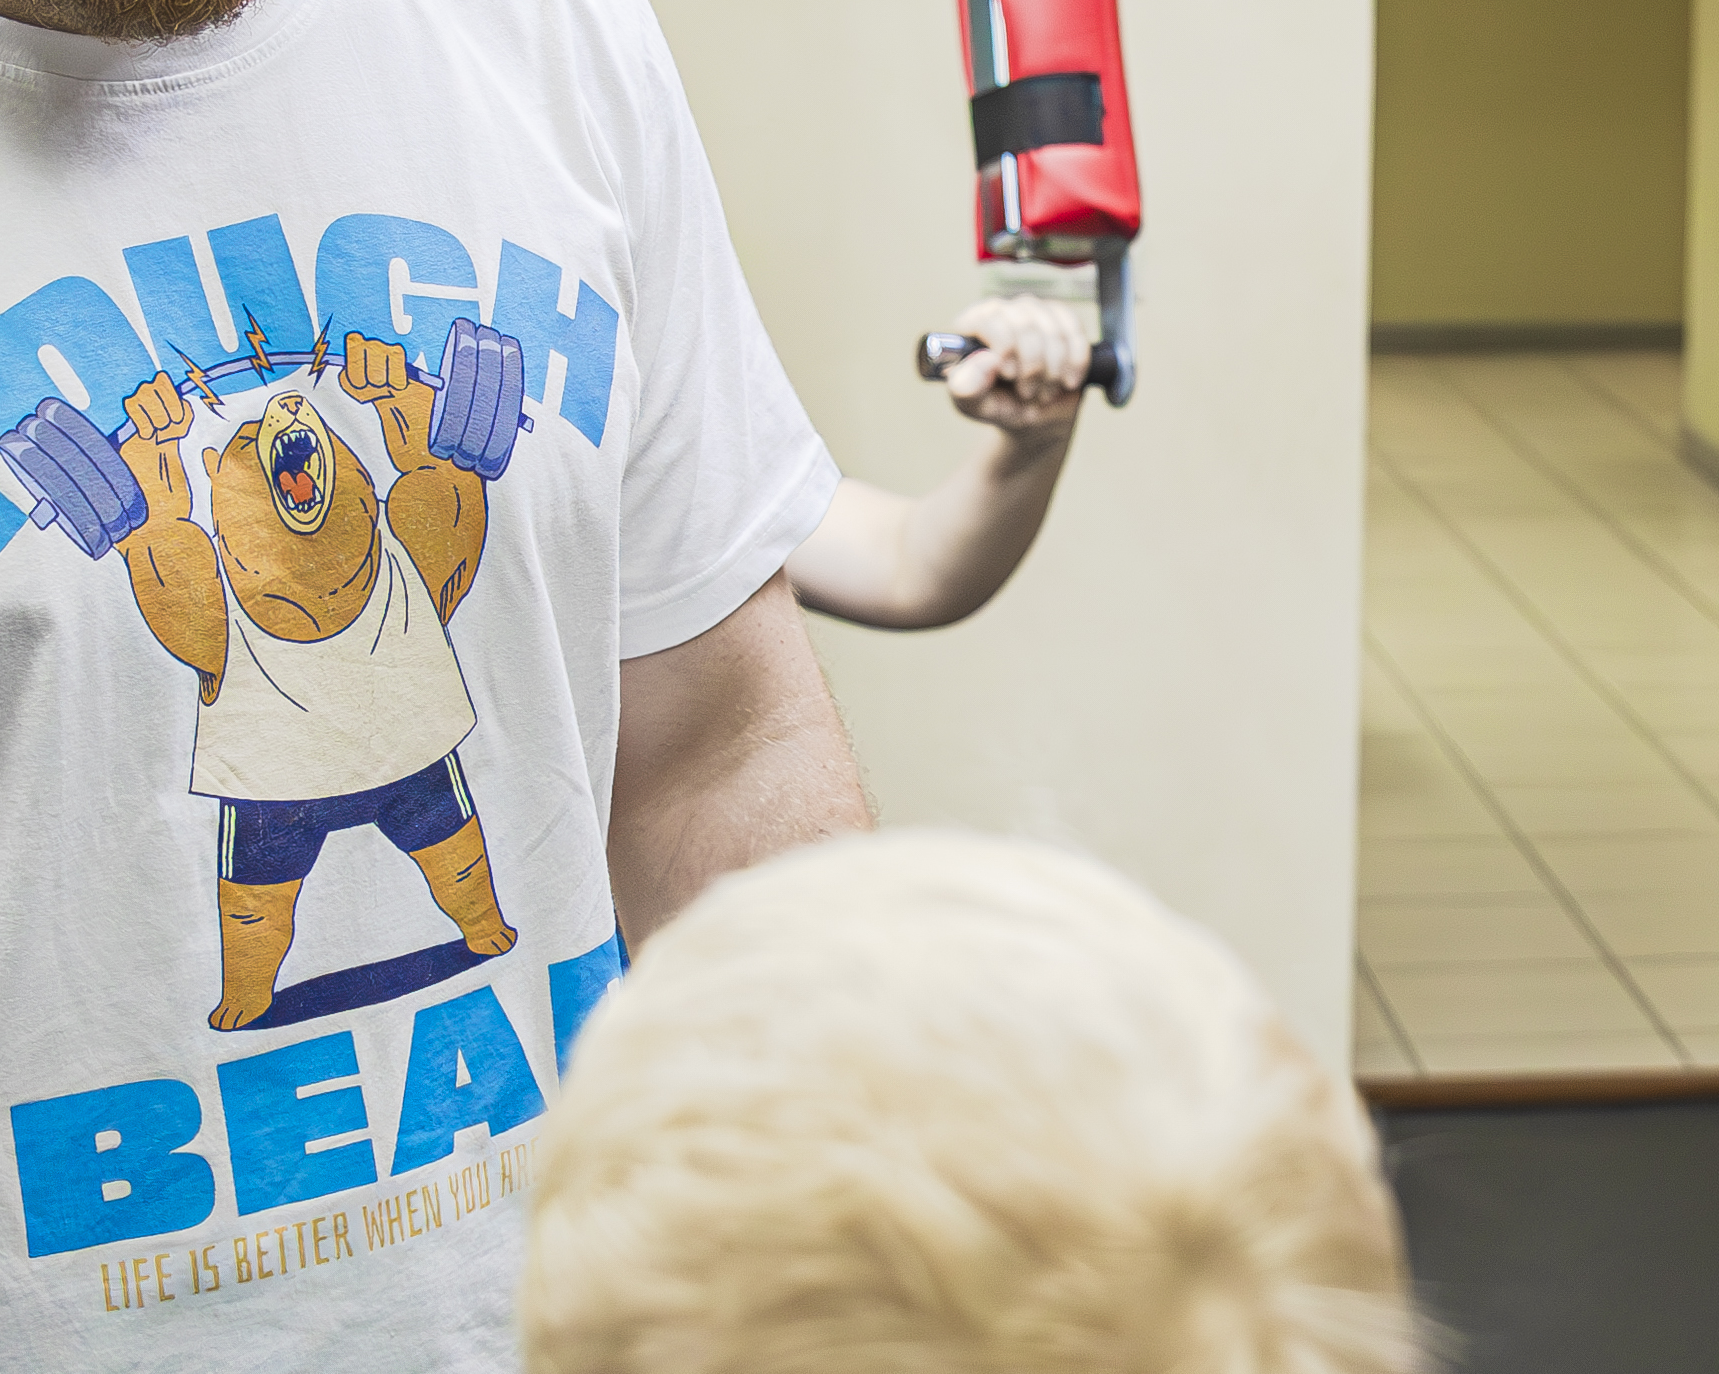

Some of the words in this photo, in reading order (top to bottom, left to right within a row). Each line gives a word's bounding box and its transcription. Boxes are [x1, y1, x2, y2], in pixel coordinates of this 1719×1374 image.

[100, 1252, 176, 1312] LIFE
[188, 1244, 221, 1295] IS
[233, 1211, 353, 1284] BETTER
[361, 1180, 442, 1253] WHEN
[447, 1160, 491, 1222] YOU
